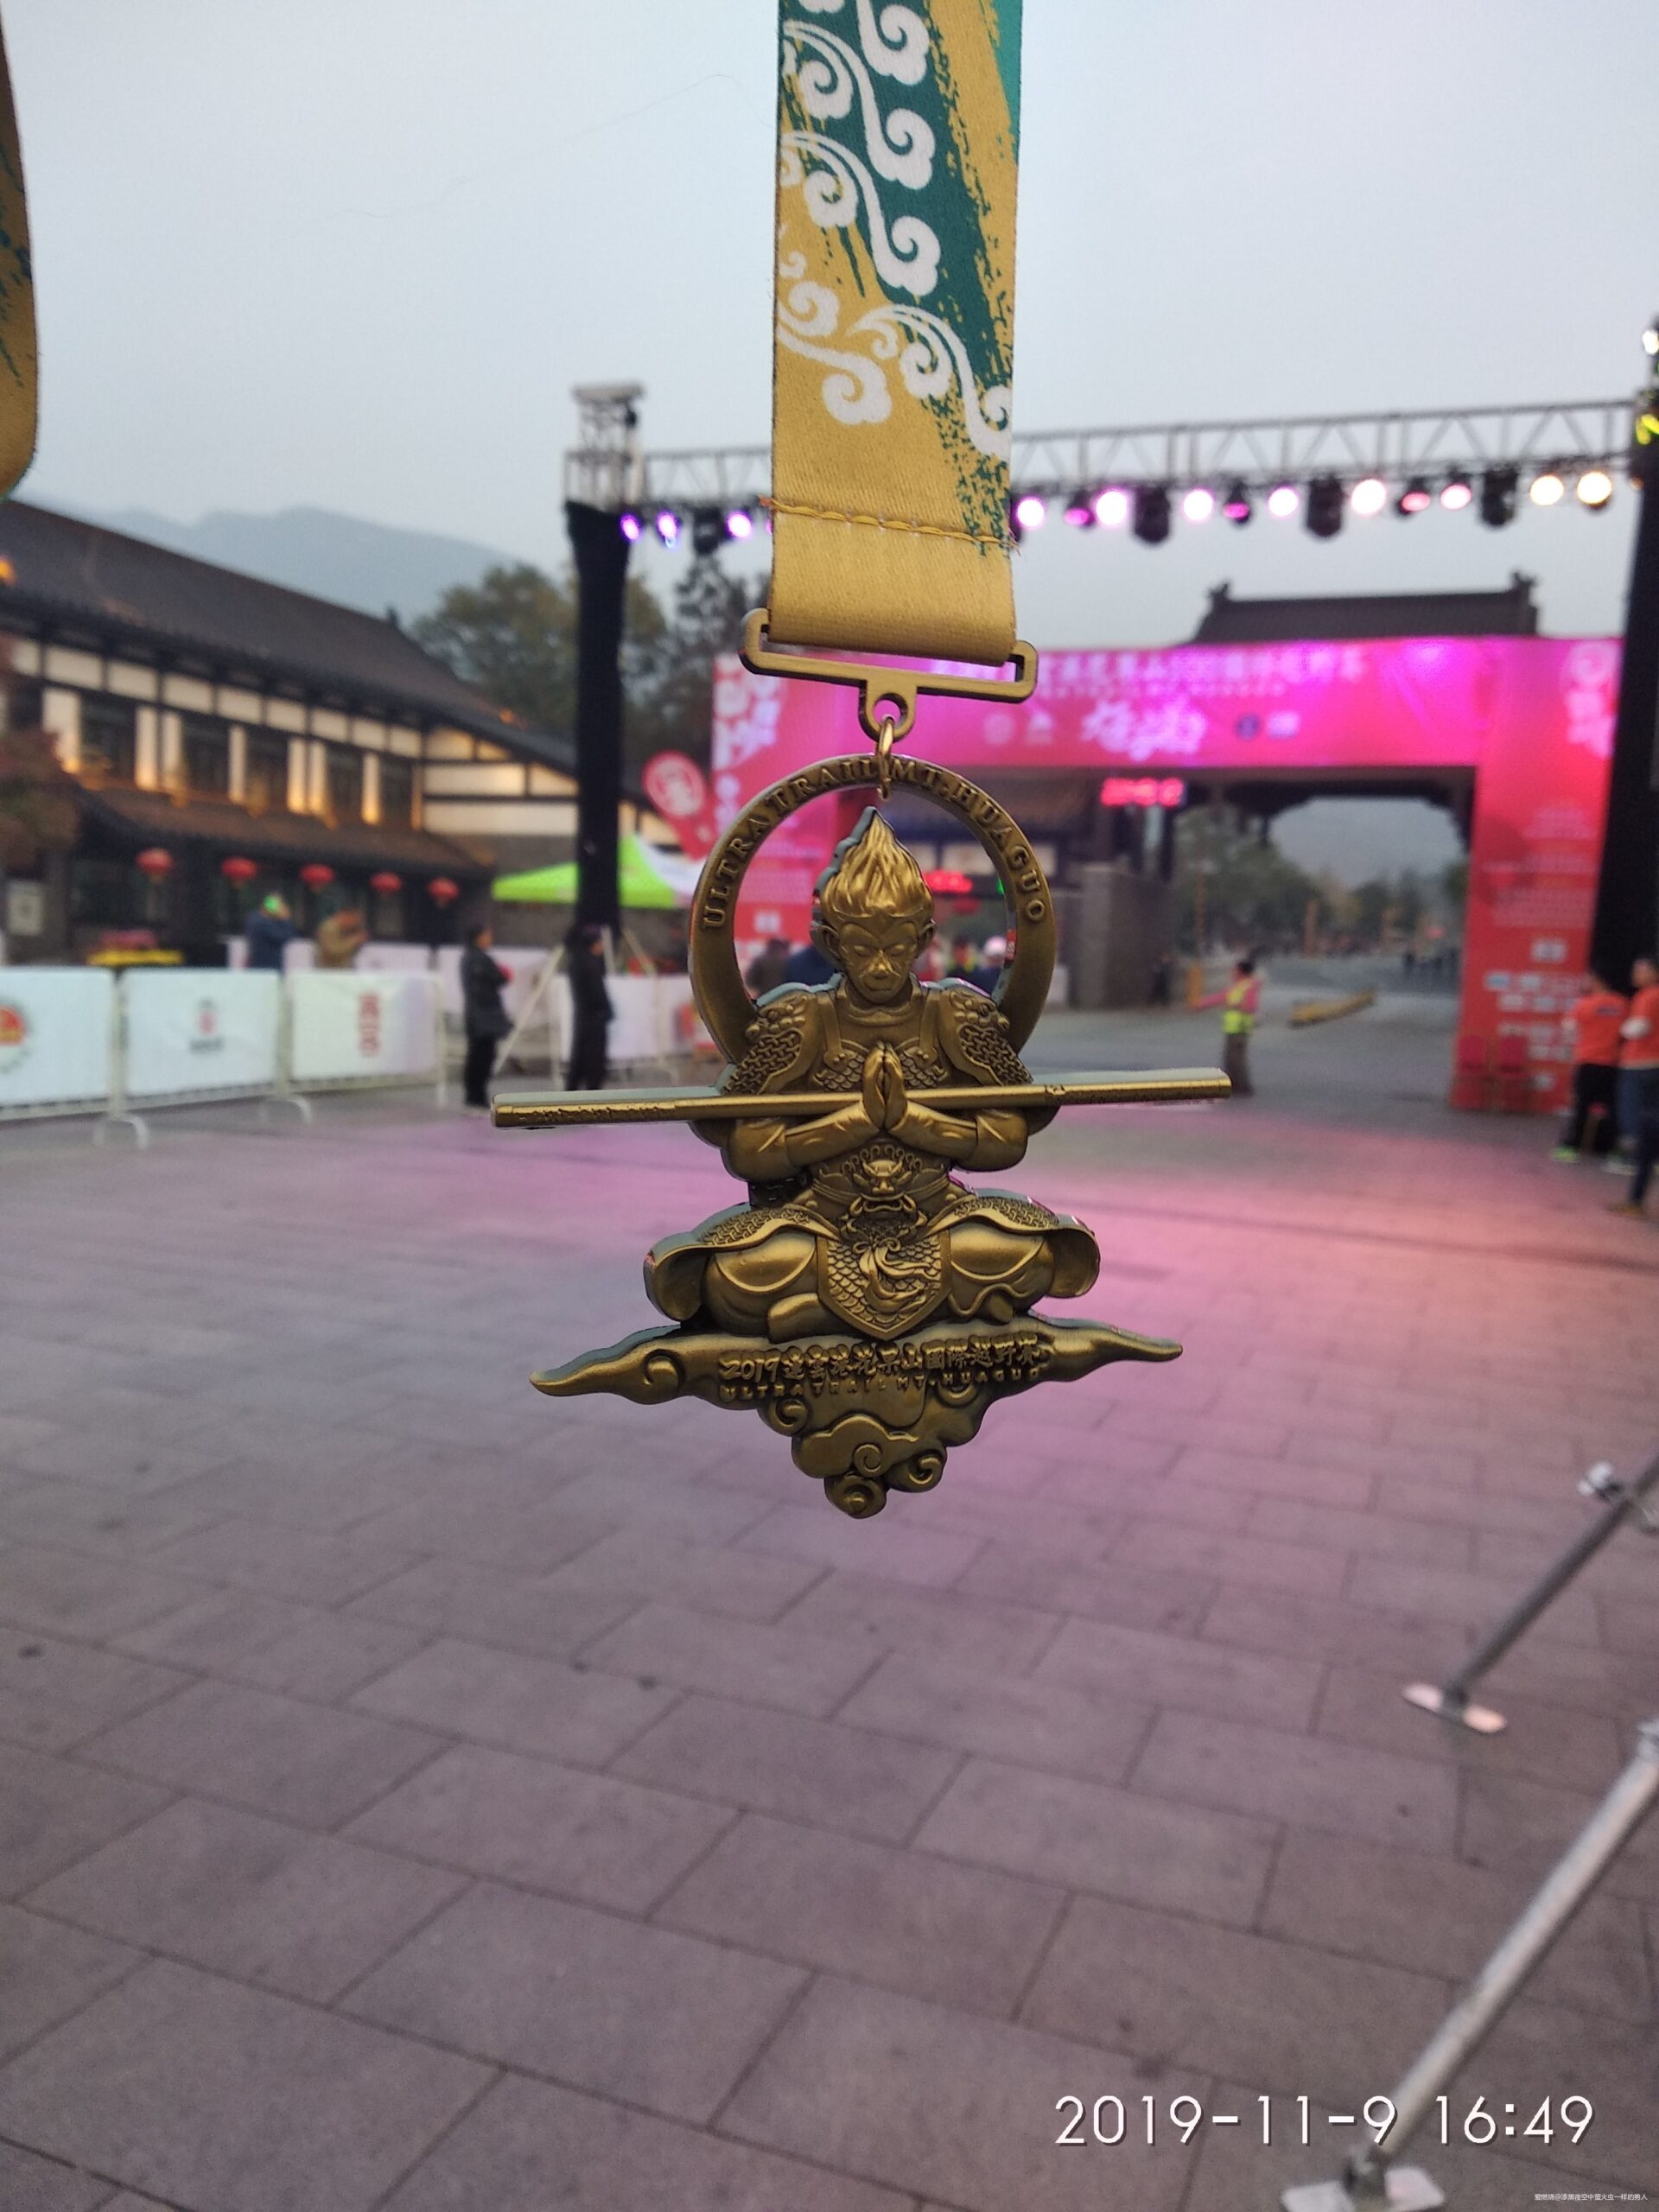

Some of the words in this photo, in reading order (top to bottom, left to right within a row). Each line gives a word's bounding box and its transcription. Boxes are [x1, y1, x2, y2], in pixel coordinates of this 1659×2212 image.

[702, 817, 770, 929] ULTRA
[765, 759, 877, 810] TRAIL
[719, 1382, 804, 1402] ULTRA
[811, 1377, 887, 1395] TRAIL
